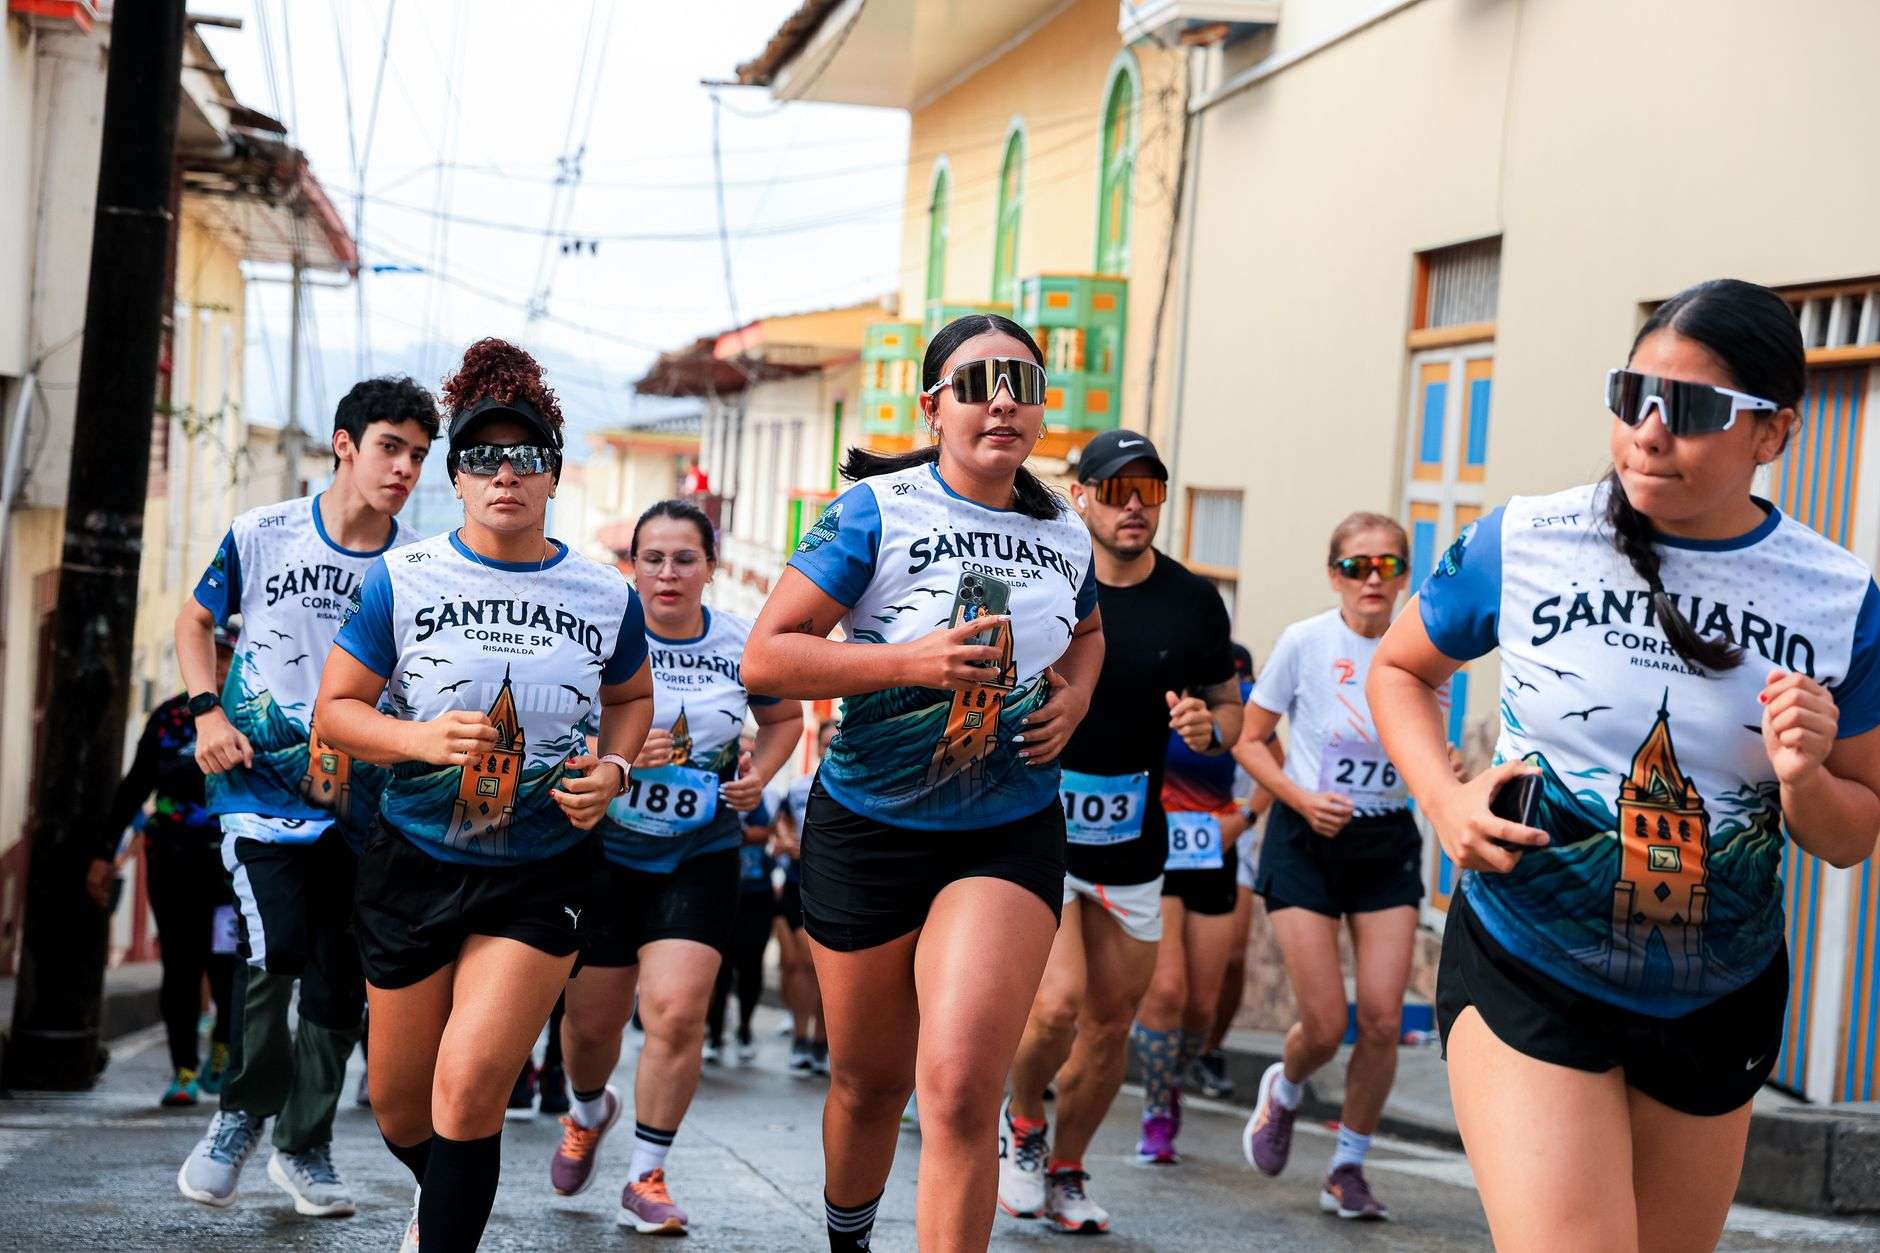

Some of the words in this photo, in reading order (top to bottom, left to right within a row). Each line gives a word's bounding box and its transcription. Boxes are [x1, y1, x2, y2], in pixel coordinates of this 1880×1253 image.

[258, 515, 288, 529] 2FIT
[1531, 513, 1581, 528] 2FIT
[908, 531, 1079, 592] SANTUARIO
[961, 560, 1017, 578] CORRE
[1020, 568, 1044, 580] 5K
[265, 564, 361, 607] SANTU
[415, 599, 604, 657] SANTUARIO
[463, 628, 525, 645] CORRE
[530, 634, 553, 648] 5K
[482, 644, 535, 656] RISARALDA
[654, 671, 695, 685] CORRE
[698, 674, 714, 684] 5K
[1335, 757, 1397, 787] 276
[628, 780, 699, 819] 188
[1064, 791, 1129, 823] 103
[1173, 828, 1210, 850] 80
